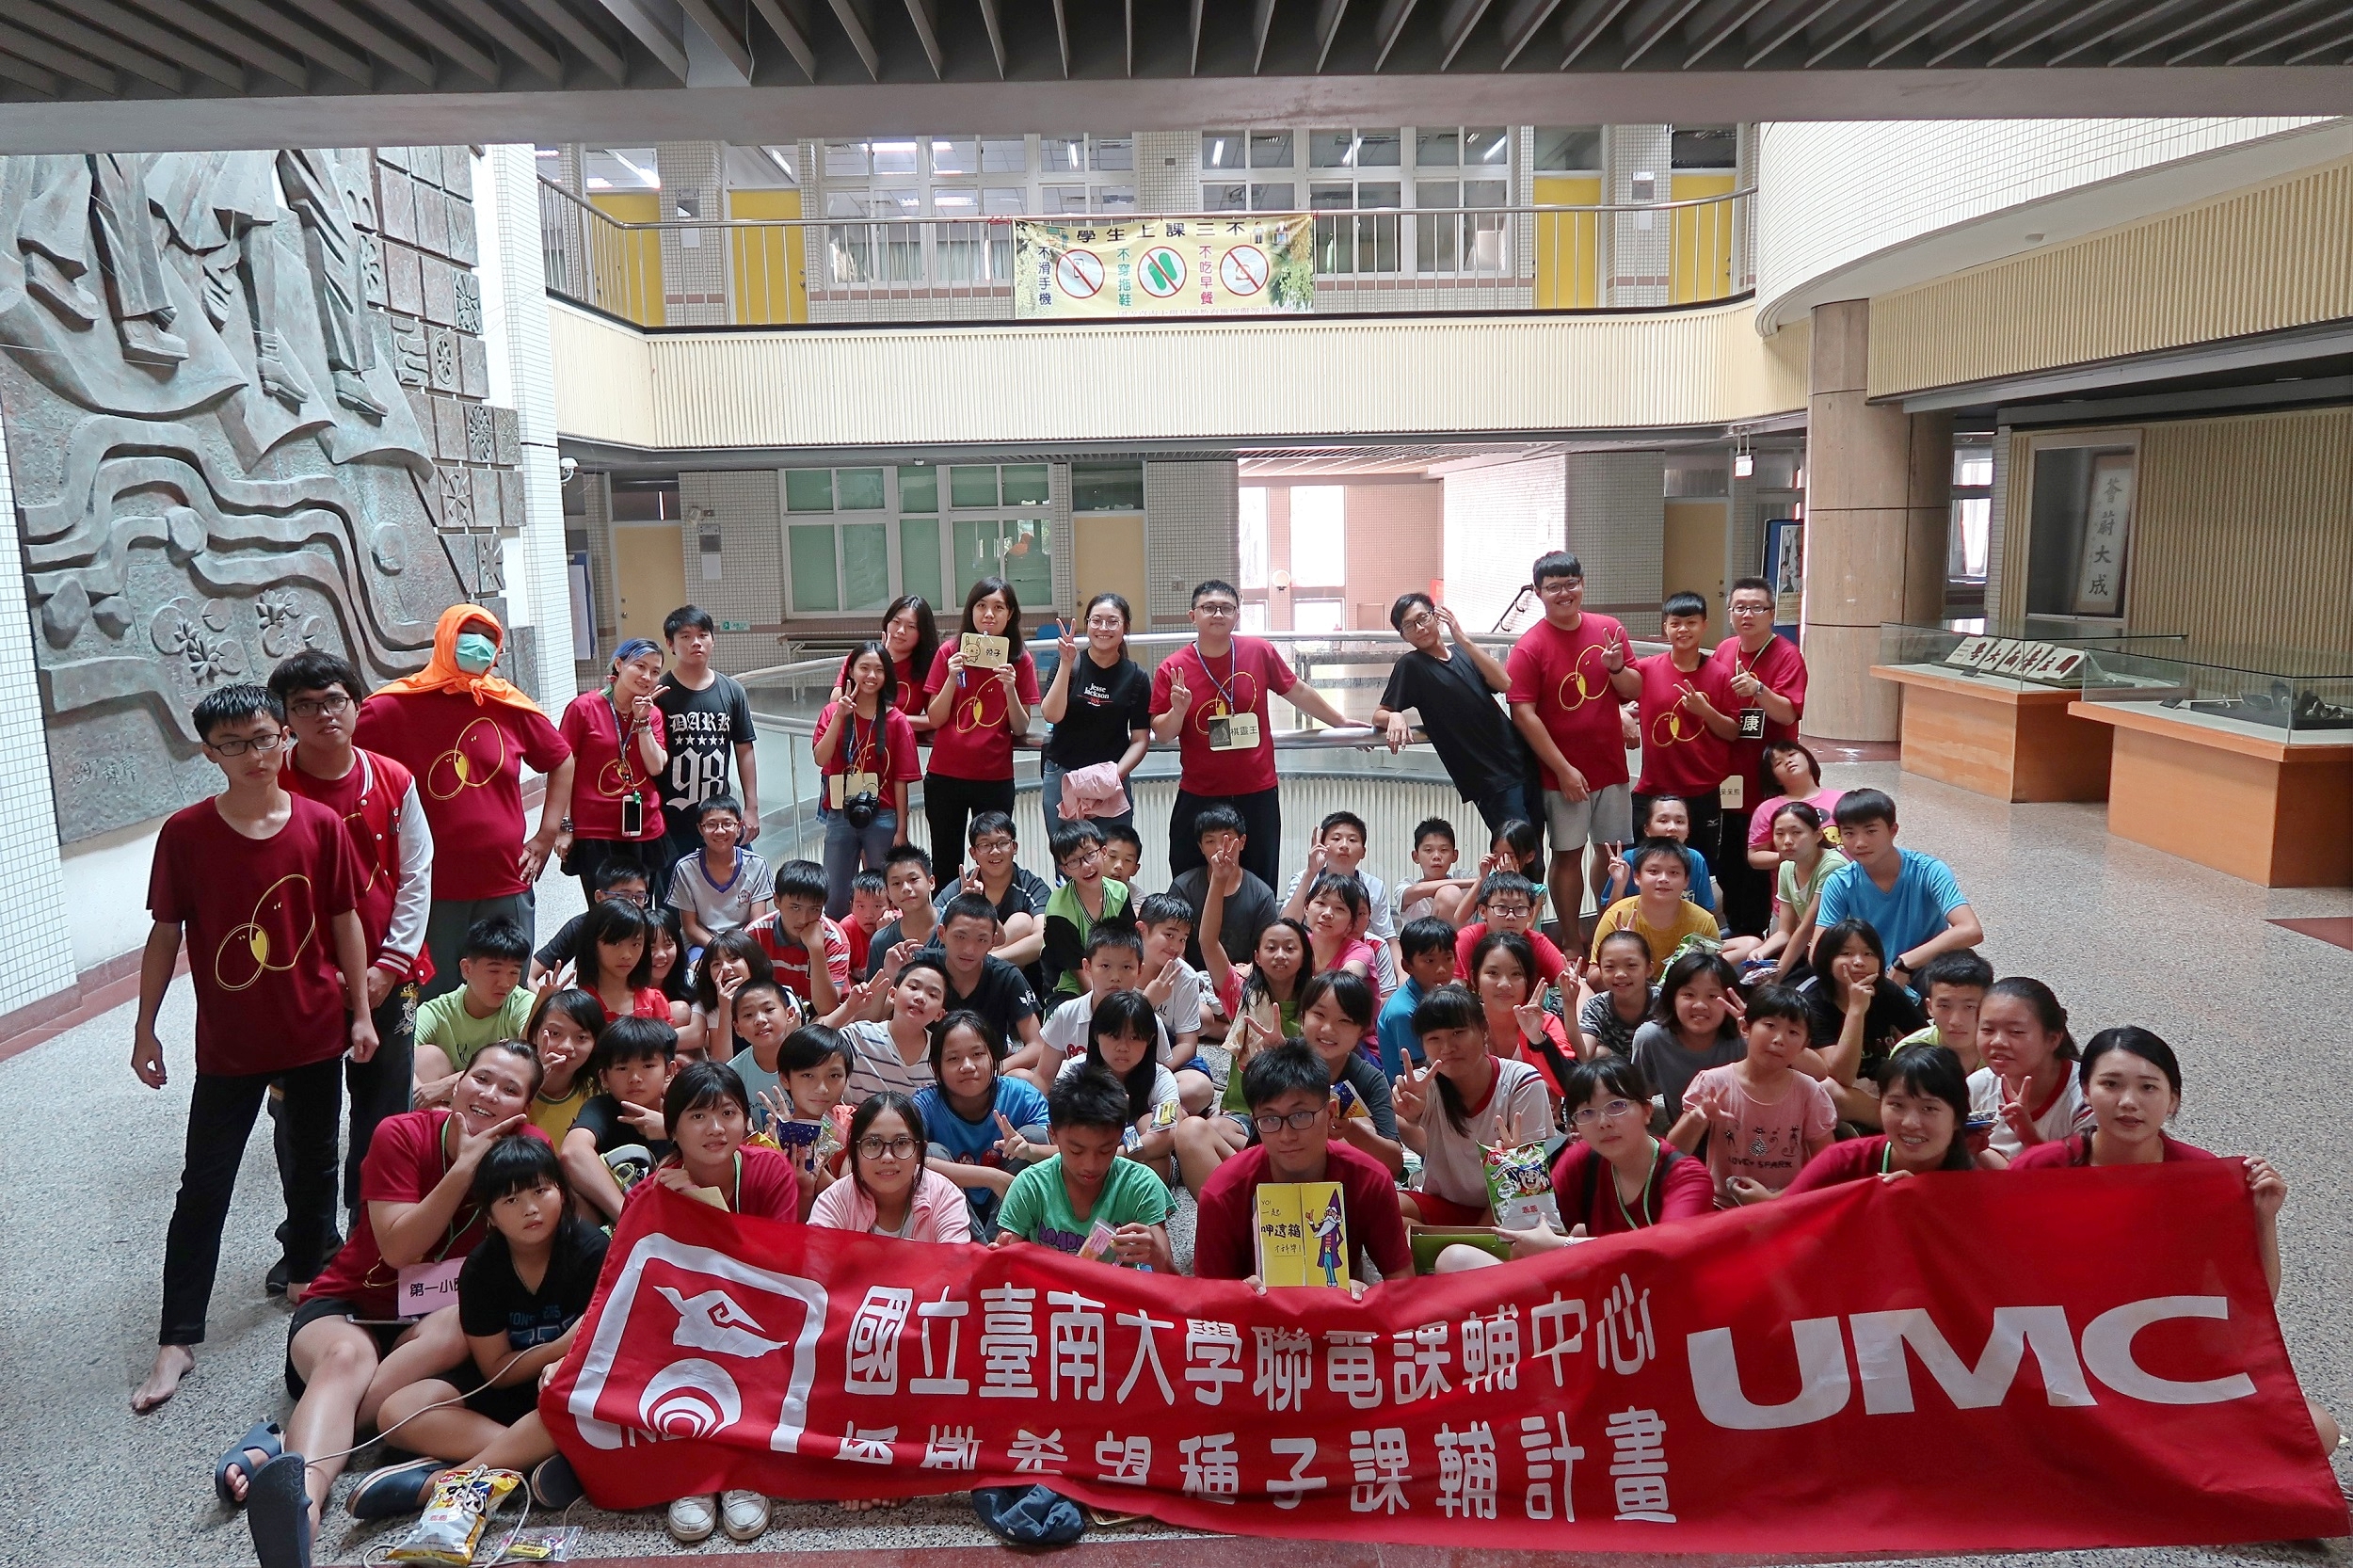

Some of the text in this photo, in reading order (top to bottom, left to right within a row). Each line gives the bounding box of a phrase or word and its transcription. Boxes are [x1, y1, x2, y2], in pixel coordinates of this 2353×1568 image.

[1077, 221, 1245, 243] 學生上課三不
[1037, 246, 1052, 306] 不滑手機
[1116, 248, 1131, 307] 不穿拖鞋
[1199, 245, 1213, 305] 不吃早餐
[1083, 687, 1110, 699] Jackson
[1089, 682, 1107, 693] Jesse
[667, 712, 730, 733] DARK
[1739, 714, 1760, 731] 康
[666, 747, 726, 811] 98
[1261, 1223, 1302, 1239] 呷這箱
[844, 1273, 1657, 1413] 國立臺南大學聯電課輔中心
[1686, 1295, 2257, 1431] UMC
